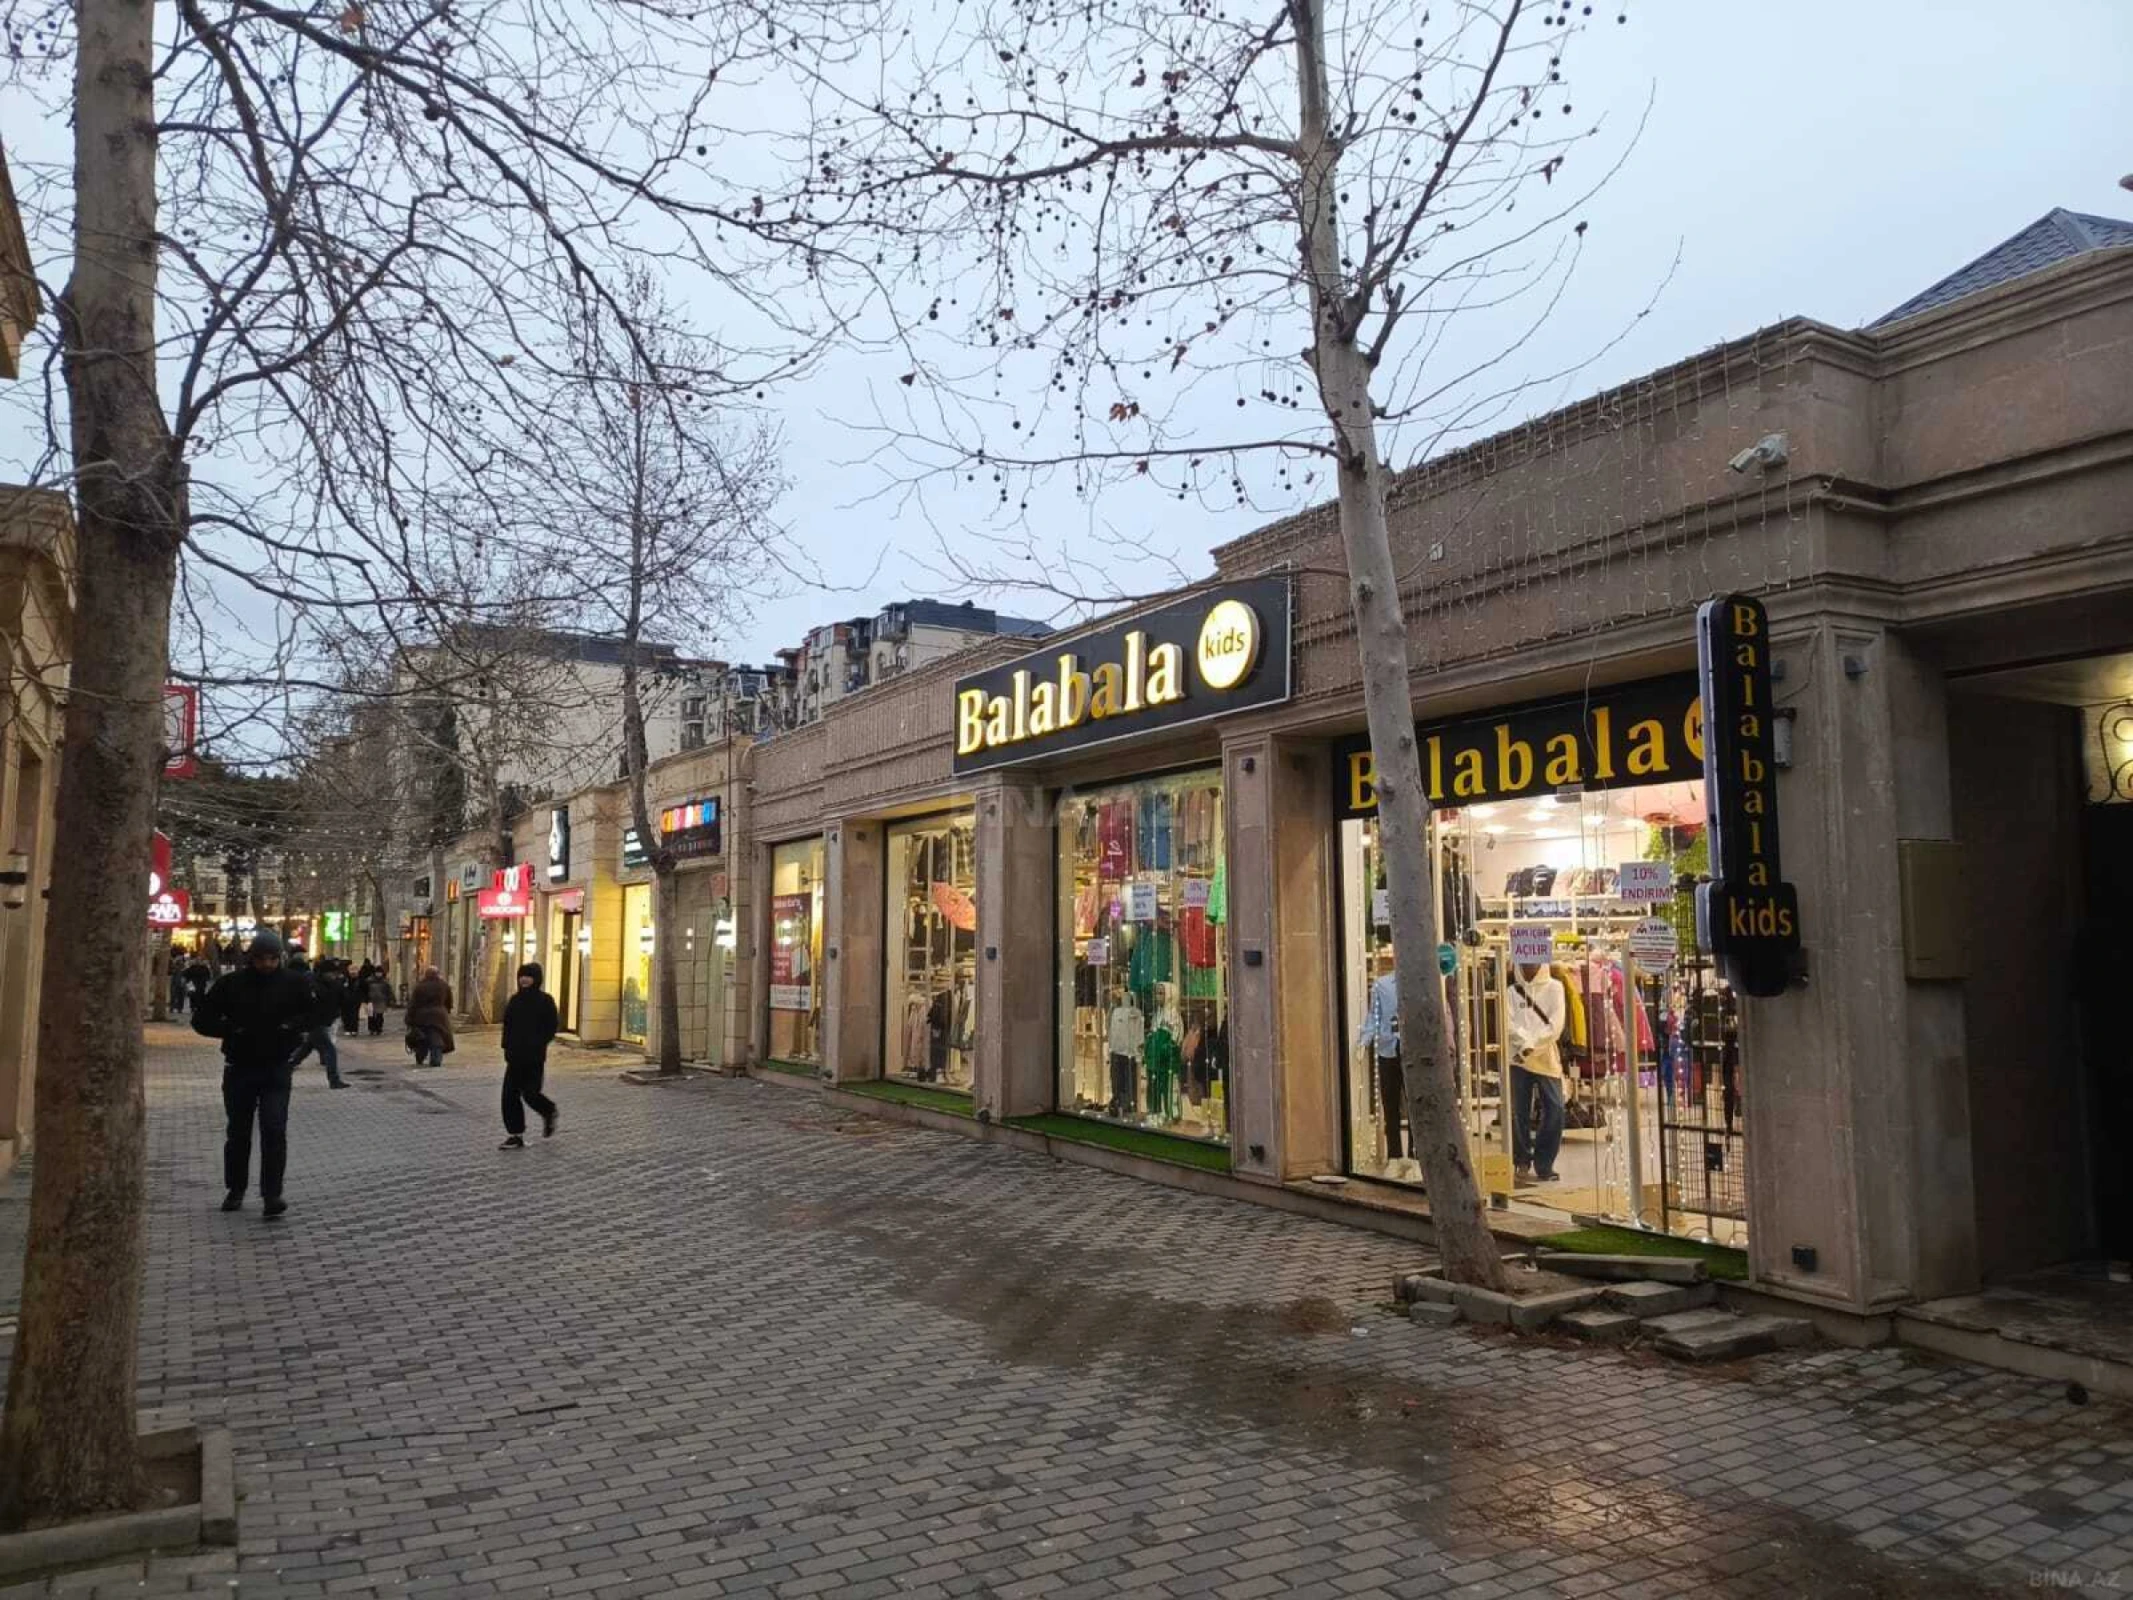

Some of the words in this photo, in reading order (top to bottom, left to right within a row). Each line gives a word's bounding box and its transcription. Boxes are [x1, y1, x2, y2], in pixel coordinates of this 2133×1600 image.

[1206, 627, 1245, 660] kids
[958, 631, 1185, 754] Balabala
[1348, 707, 1670, 810] Blabala
[1734, 604, 1768, 886] Balabala
[1632, 867, 1658, 880] 10%
[1730, 897, 1793, 937] kids
